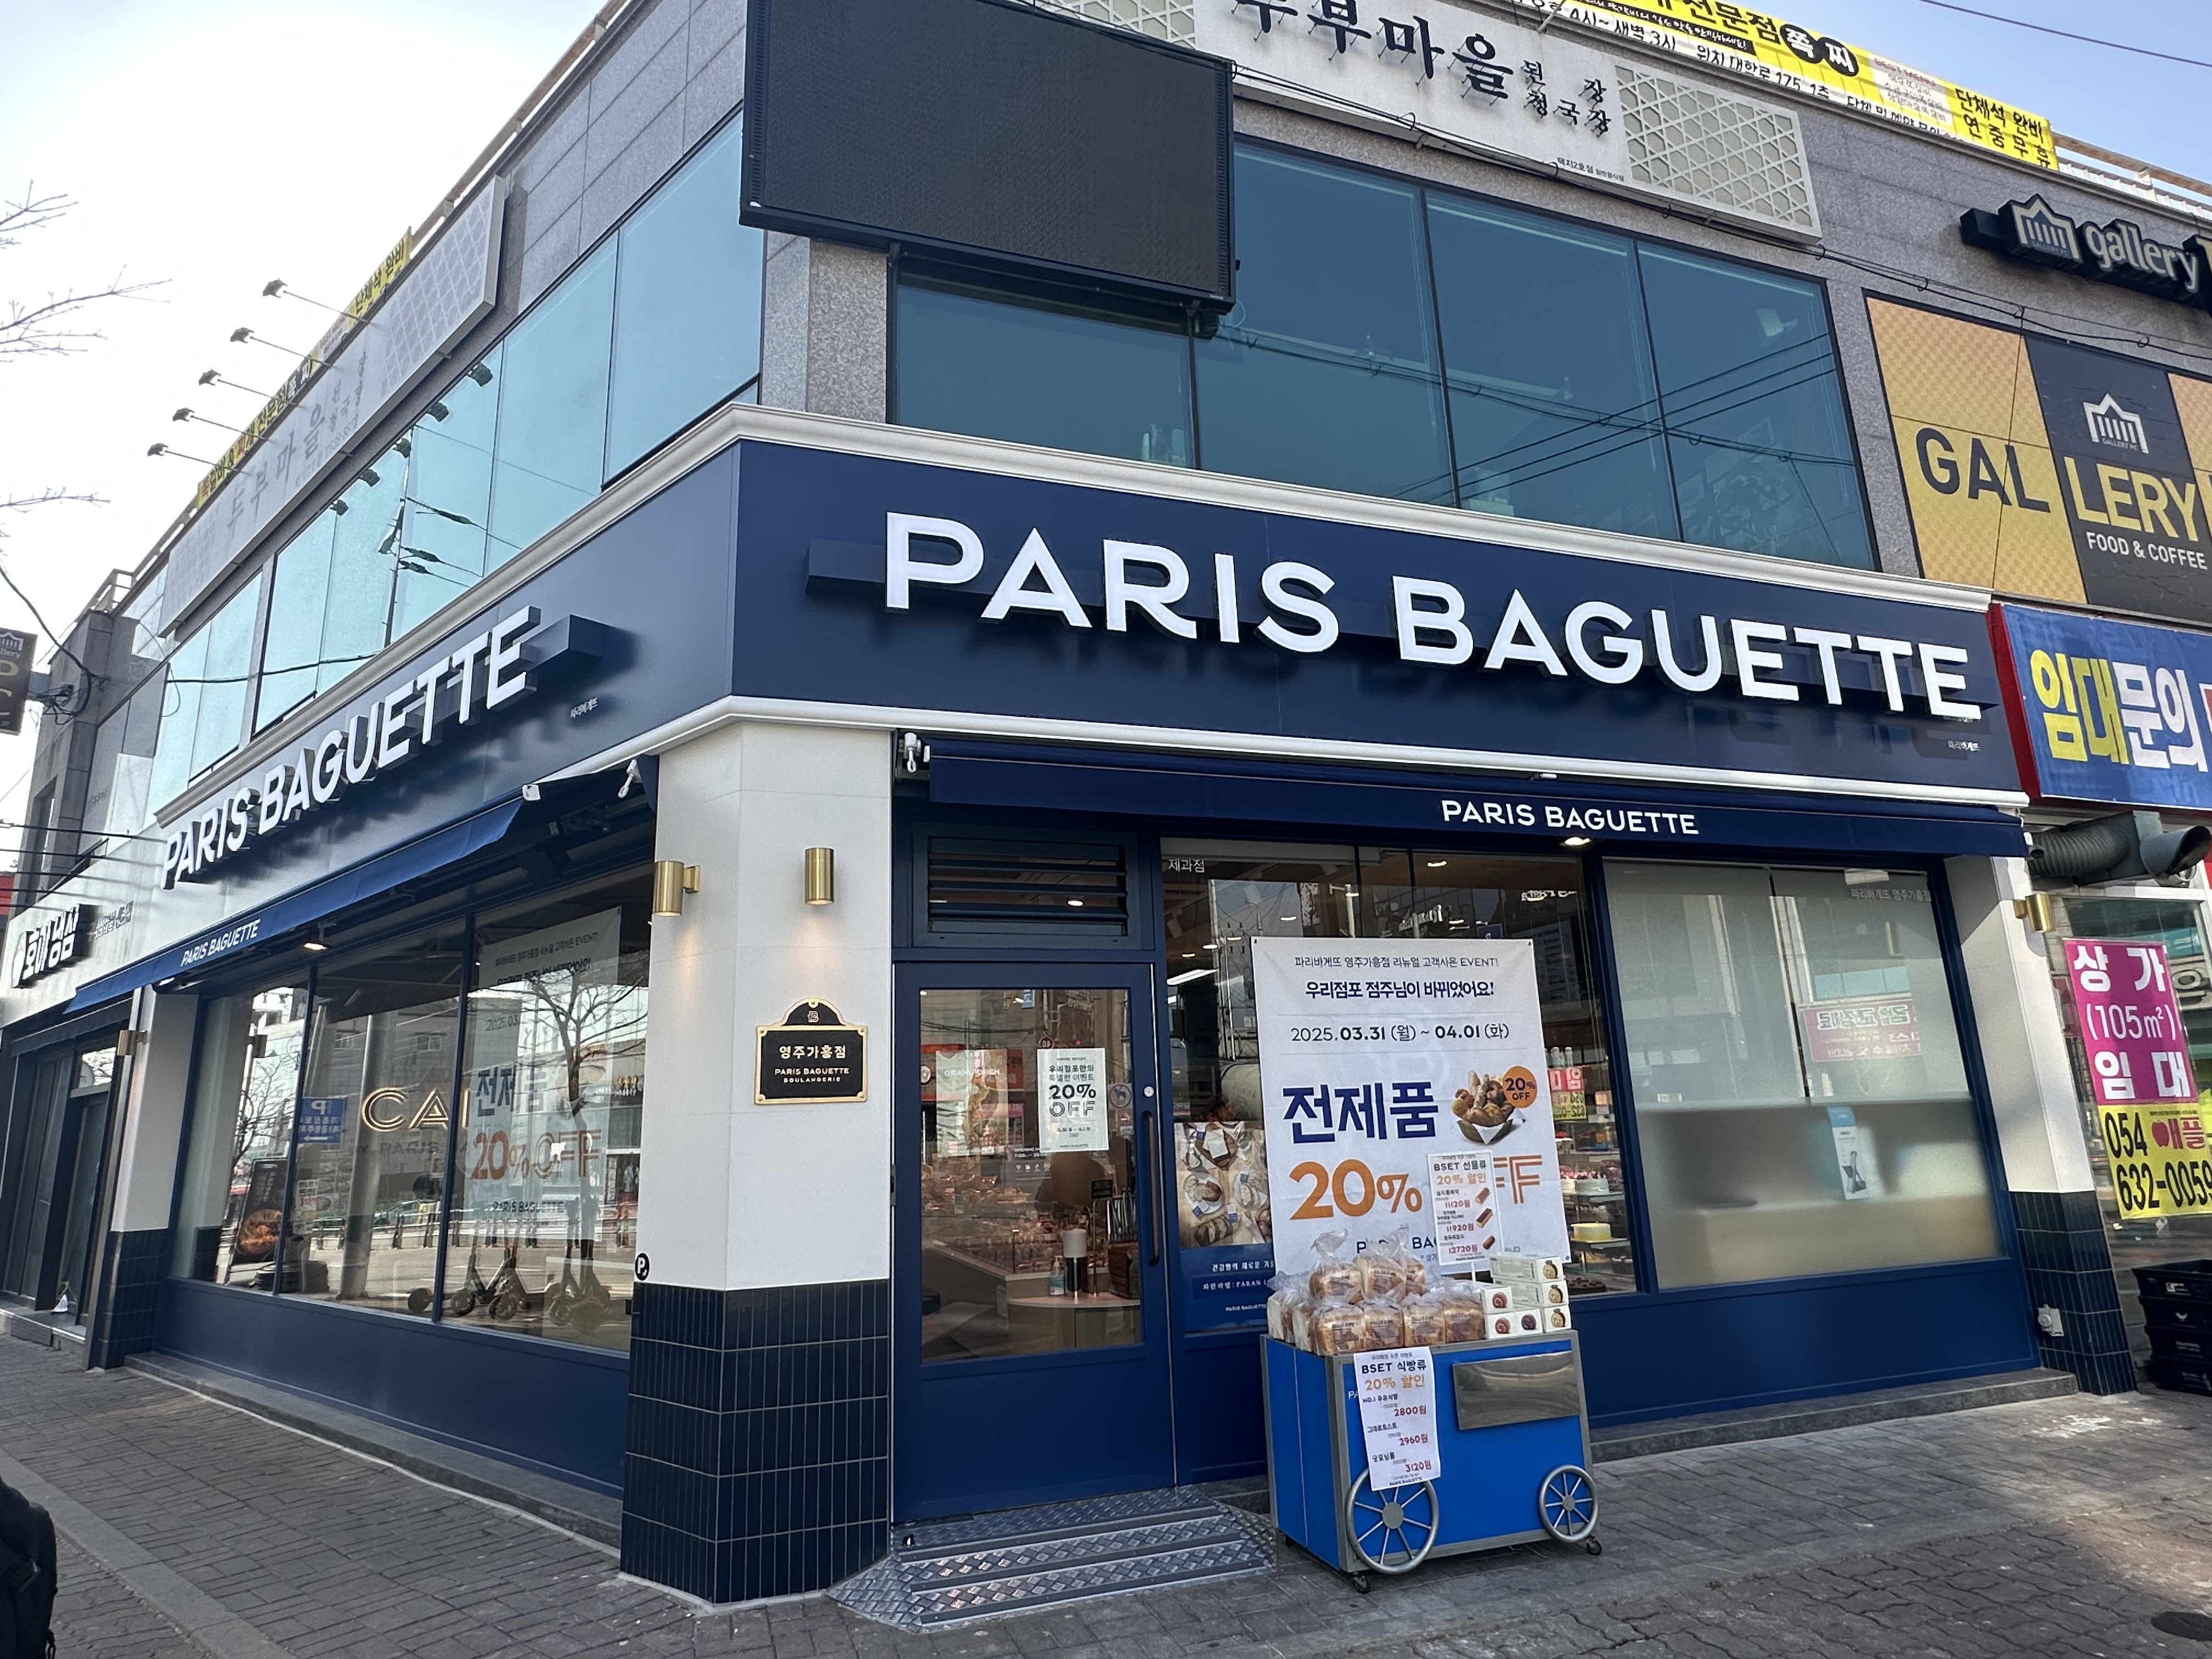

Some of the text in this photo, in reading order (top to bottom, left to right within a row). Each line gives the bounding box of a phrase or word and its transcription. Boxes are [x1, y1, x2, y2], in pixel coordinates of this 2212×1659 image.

[1697, 44, 1725, 66] 위치
[1730, 56, 1770, 78] 대학로
[1955, 88, 2006, 128] 단체석
[2013, 111, 2044, 144] 완비
[2085, 222, 2197, 292] gallery
[2086, 532, 2208, 571] FOOD & COFFEE
[885, 511, 1982, 720] PARIS BAGUETTE
[2030, 650, 2208, 772] 임대문의
[161, 605, 540, 889] PARIS BAGUETTE
[1441, 799, 1700, 835] PARIS BAGUETTE
[1168, 858, 1205, 873] 제과점
[180, 918, 261, 967] PARIS BAGUETTE
[1295, 956, 1499, 968] 파리바게뜨 영주가흥점 리뉴얼 고객사은 EVENT!
[1305, 981, 1494, 998] 우리점포 점주님이 바뀌었어요!
[1291, 1025, 1386, 1042] 2025.03.31
[1435, 1024, 1481, 1040] 04.01
[779, 1045, 847, 1059] 영주가흥점
[803, 1067, 850, 1075] BAGUETTE
[1048, 1084, 1097, 1099] 20%
[1506, 1077, 1537, 1091] 20%
[1512, 1091, 1531, 1101] OFF
[1049, 1101, 1096, 1117] OFF
[1283, 1081, 1439, 1144] 전제품
[2105, 1111, 2148, 1159] 054
[470, 1129, 601, 1180] 20% OFF
[1434, 1162, 1460, 1171] BSET
[1437, 1172, 1487, 1185] 20% 할인
[1289, 1159, 1423, 1221] 20%
[1447, 1223, 1474, 1232] 11920원
[1449, 1245, 1478, 1254] 12720원
[1362, 1359, 1426, 1374] BSET 식빵류
[1364, 1374, 1425, 1391] 20% 할인
[1393, 1405, 1427, 1417] 2800원
[1399, 1433, 1429, 1447] 2960원
[1404, 1459, 1432, 1472] 3120원
